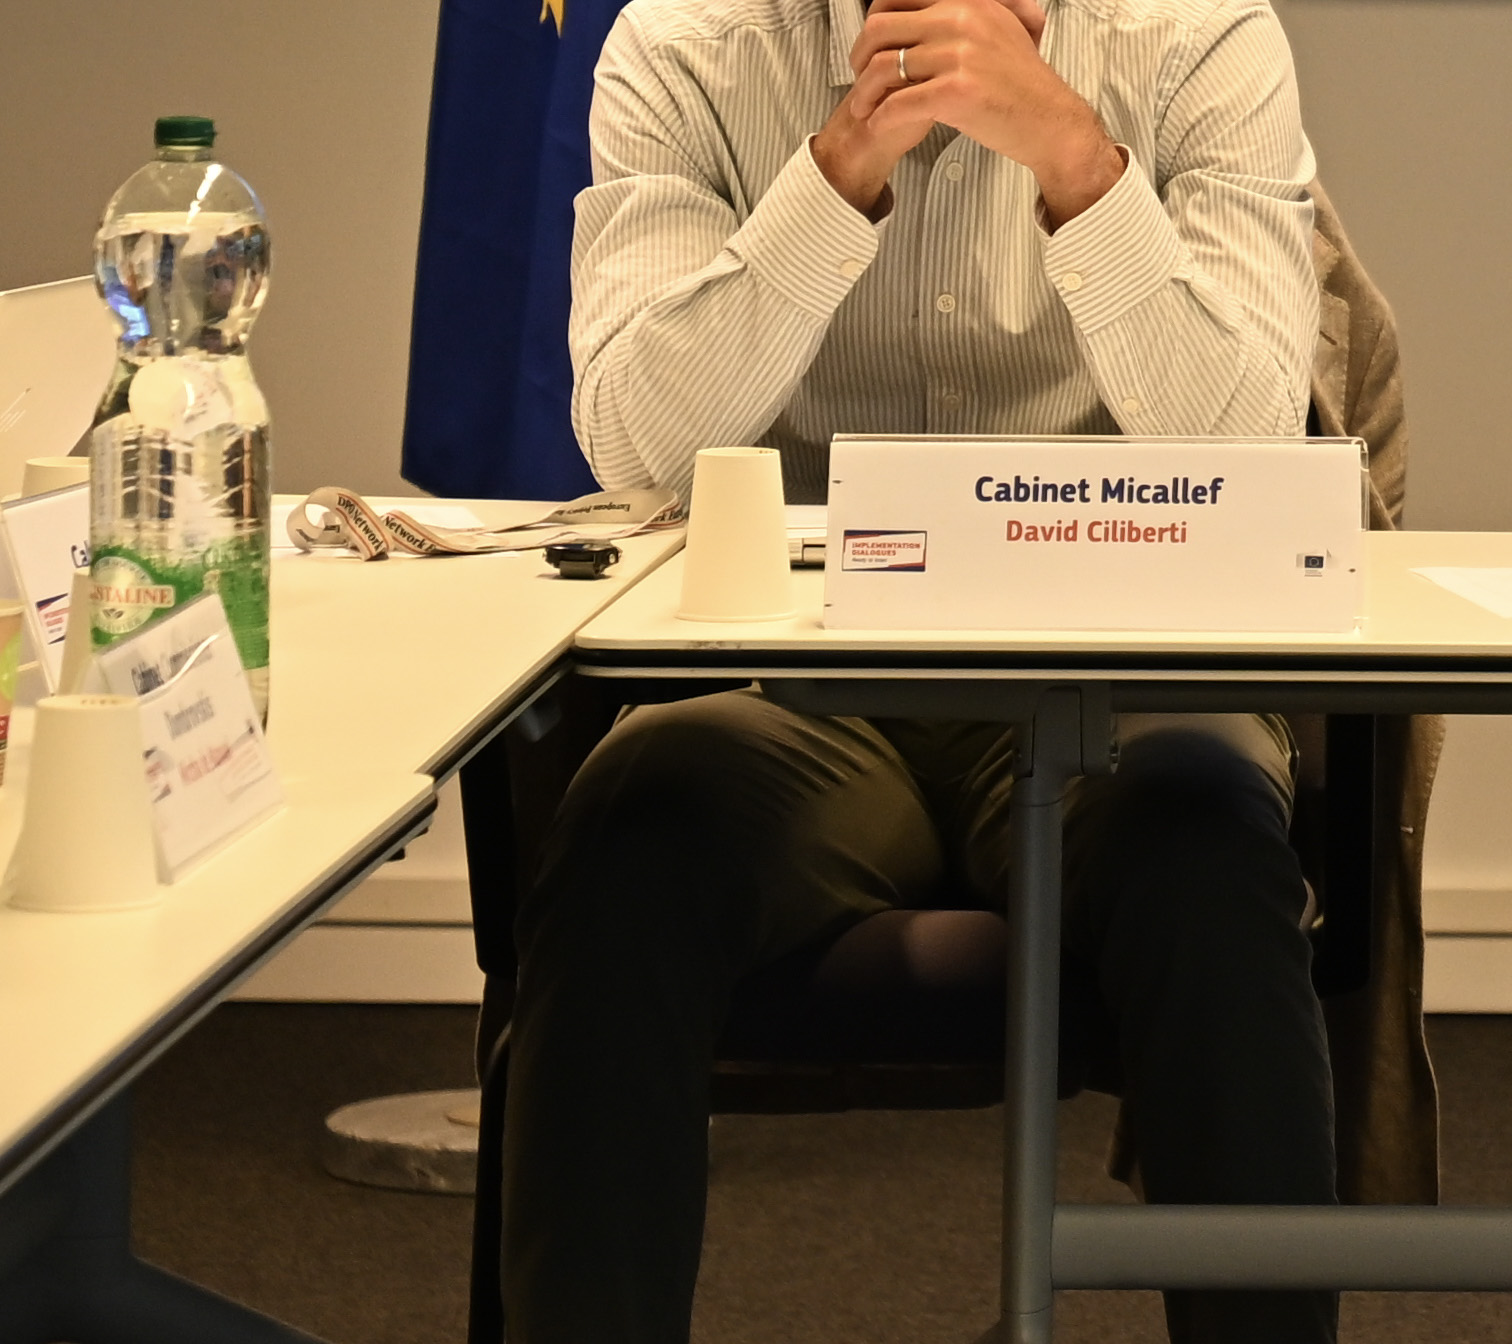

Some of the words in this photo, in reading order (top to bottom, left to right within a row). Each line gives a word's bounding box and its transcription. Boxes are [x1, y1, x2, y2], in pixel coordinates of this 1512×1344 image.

[975, 475, 1091, 503] Cabinet
[1101, 477, 1225, 504] Micallef
[351, 512, 384, 551] Network
[385, 515, 426, 550] Network
[1006, 519, 1079, 542] David
[1087, 520, 1188, 543] Ciliberti
